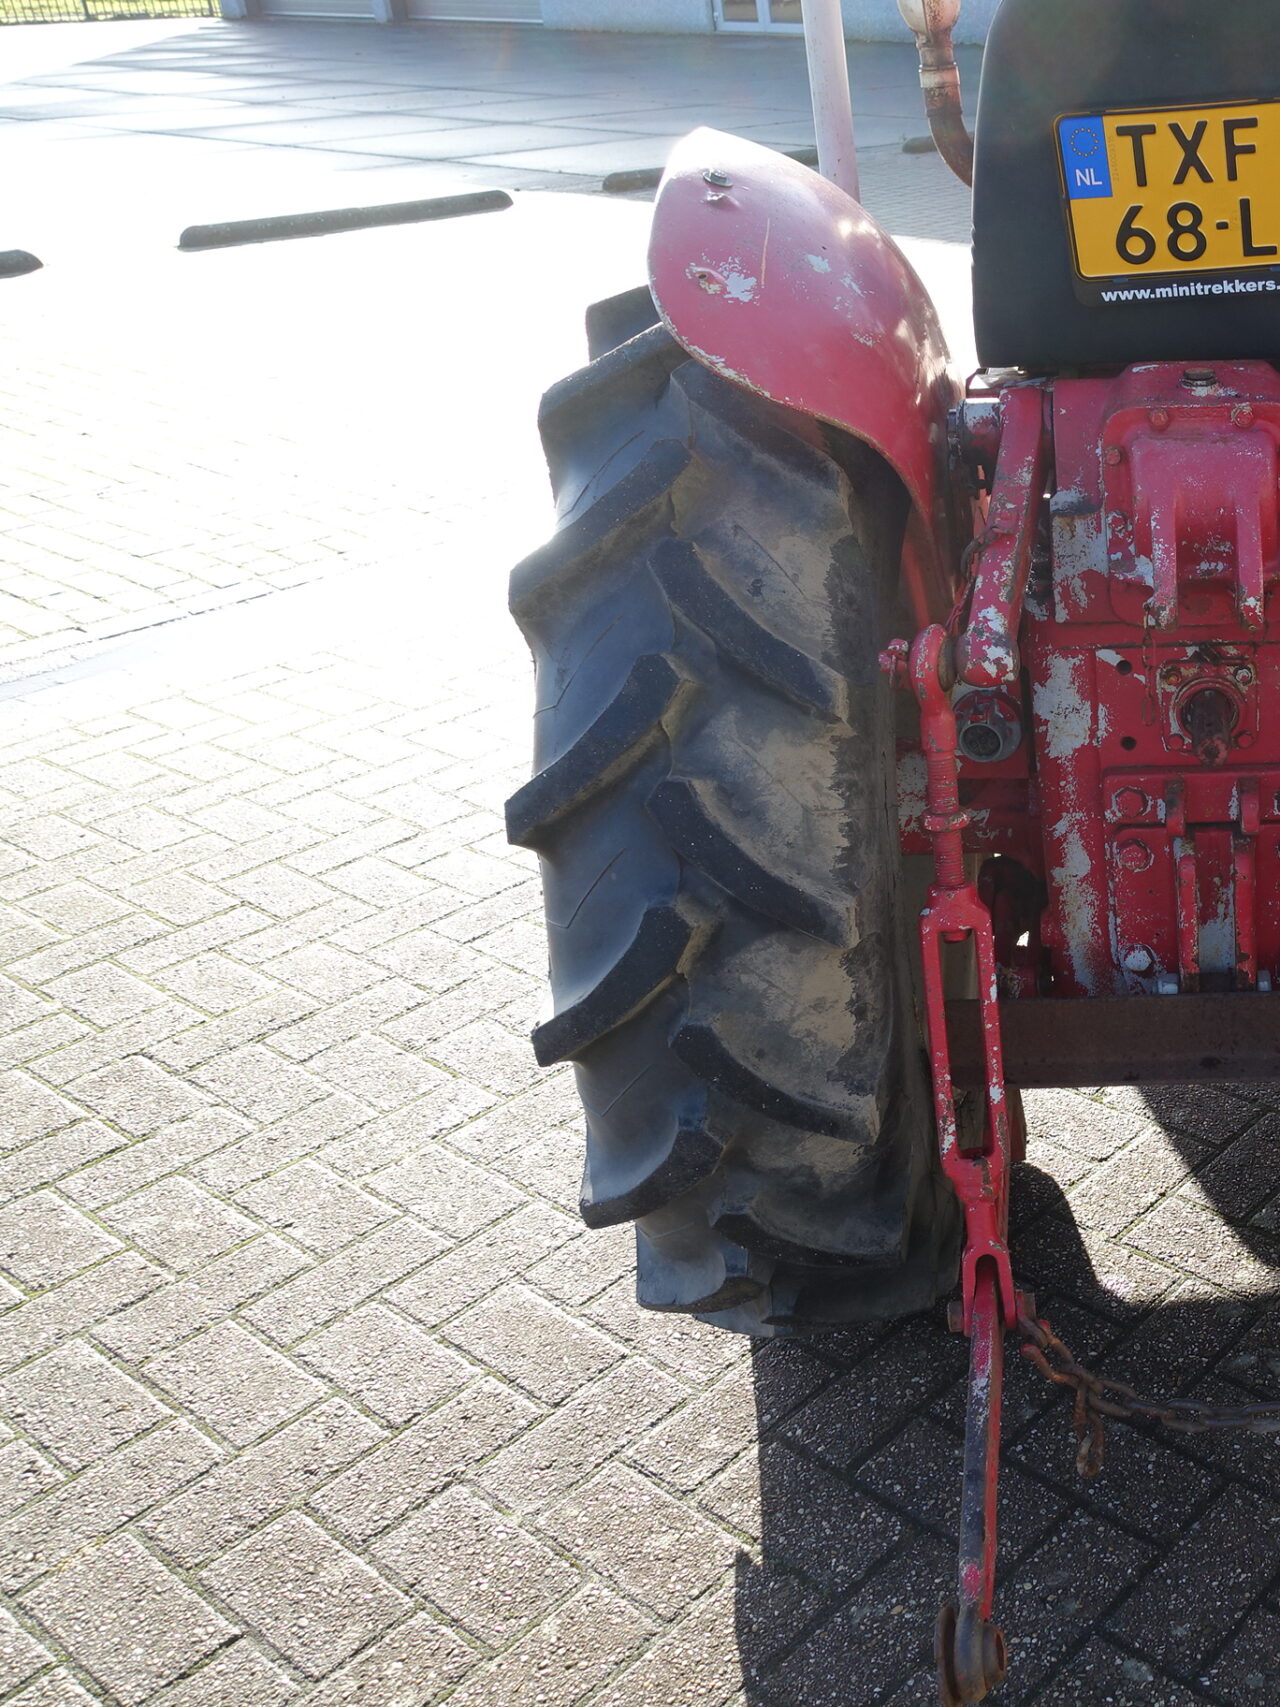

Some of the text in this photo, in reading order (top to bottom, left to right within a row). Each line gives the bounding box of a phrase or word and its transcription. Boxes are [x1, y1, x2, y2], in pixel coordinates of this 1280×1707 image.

[1075, 168, 1103, 186] NL
[1115, 117, 1258, 187] TXF
[1116, 198, 1277, 265] 68-L
